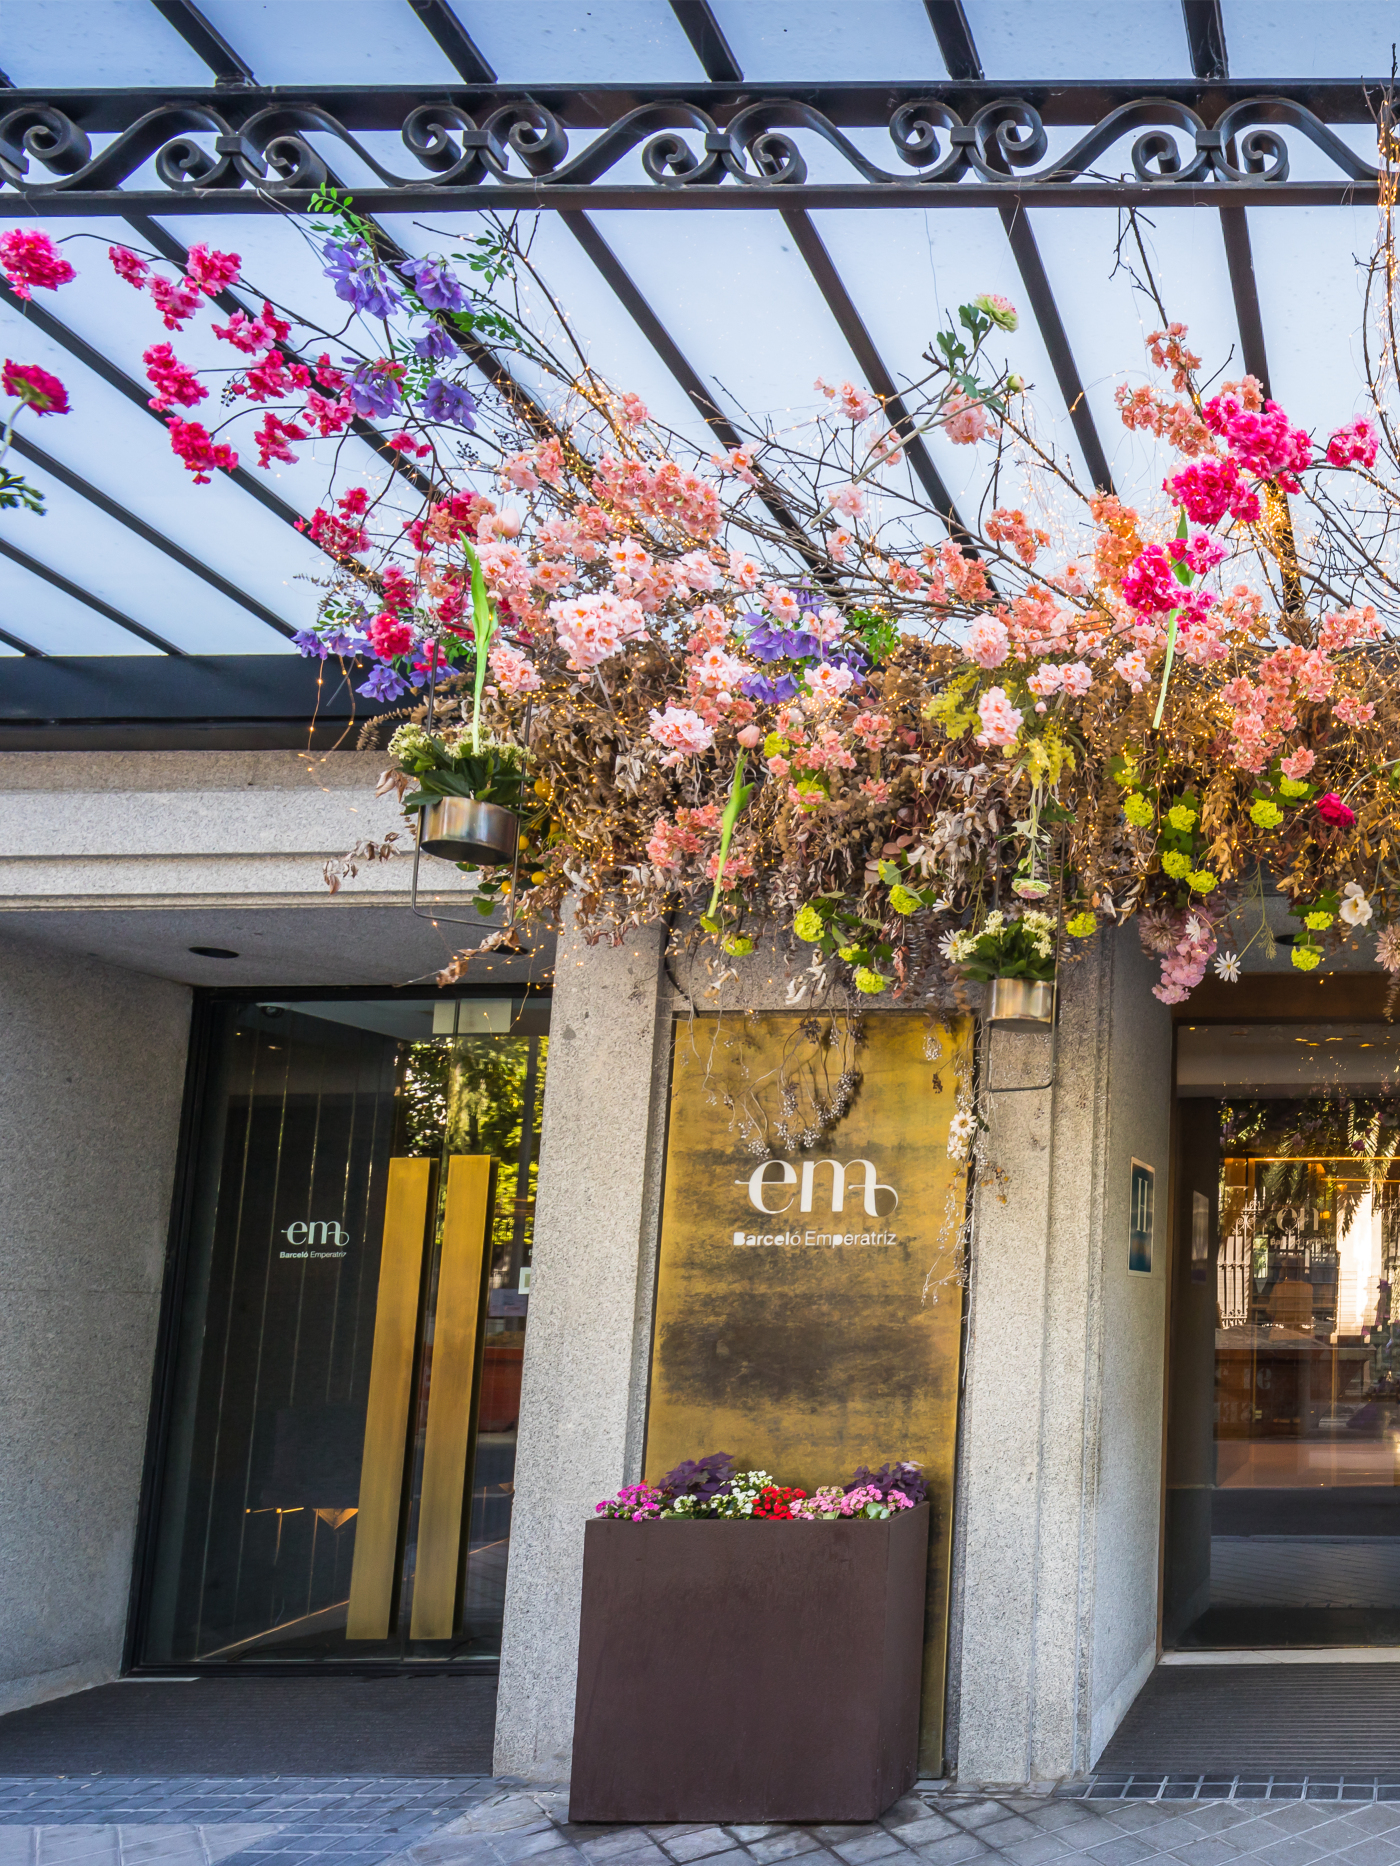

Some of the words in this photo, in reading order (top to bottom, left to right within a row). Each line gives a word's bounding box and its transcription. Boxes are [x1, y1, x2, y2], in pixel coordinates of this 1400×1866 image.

[734, 1159, 898, 1217] em
[281, 1221, 350, 1246] em
[733, 1231, 800, 1246] Barceló
[804, 1230, 897, 1249] Emperatriz
[279, 1250, 309, 1259] Barceló
[310, 1250, 348, 1260] Emperatriz
